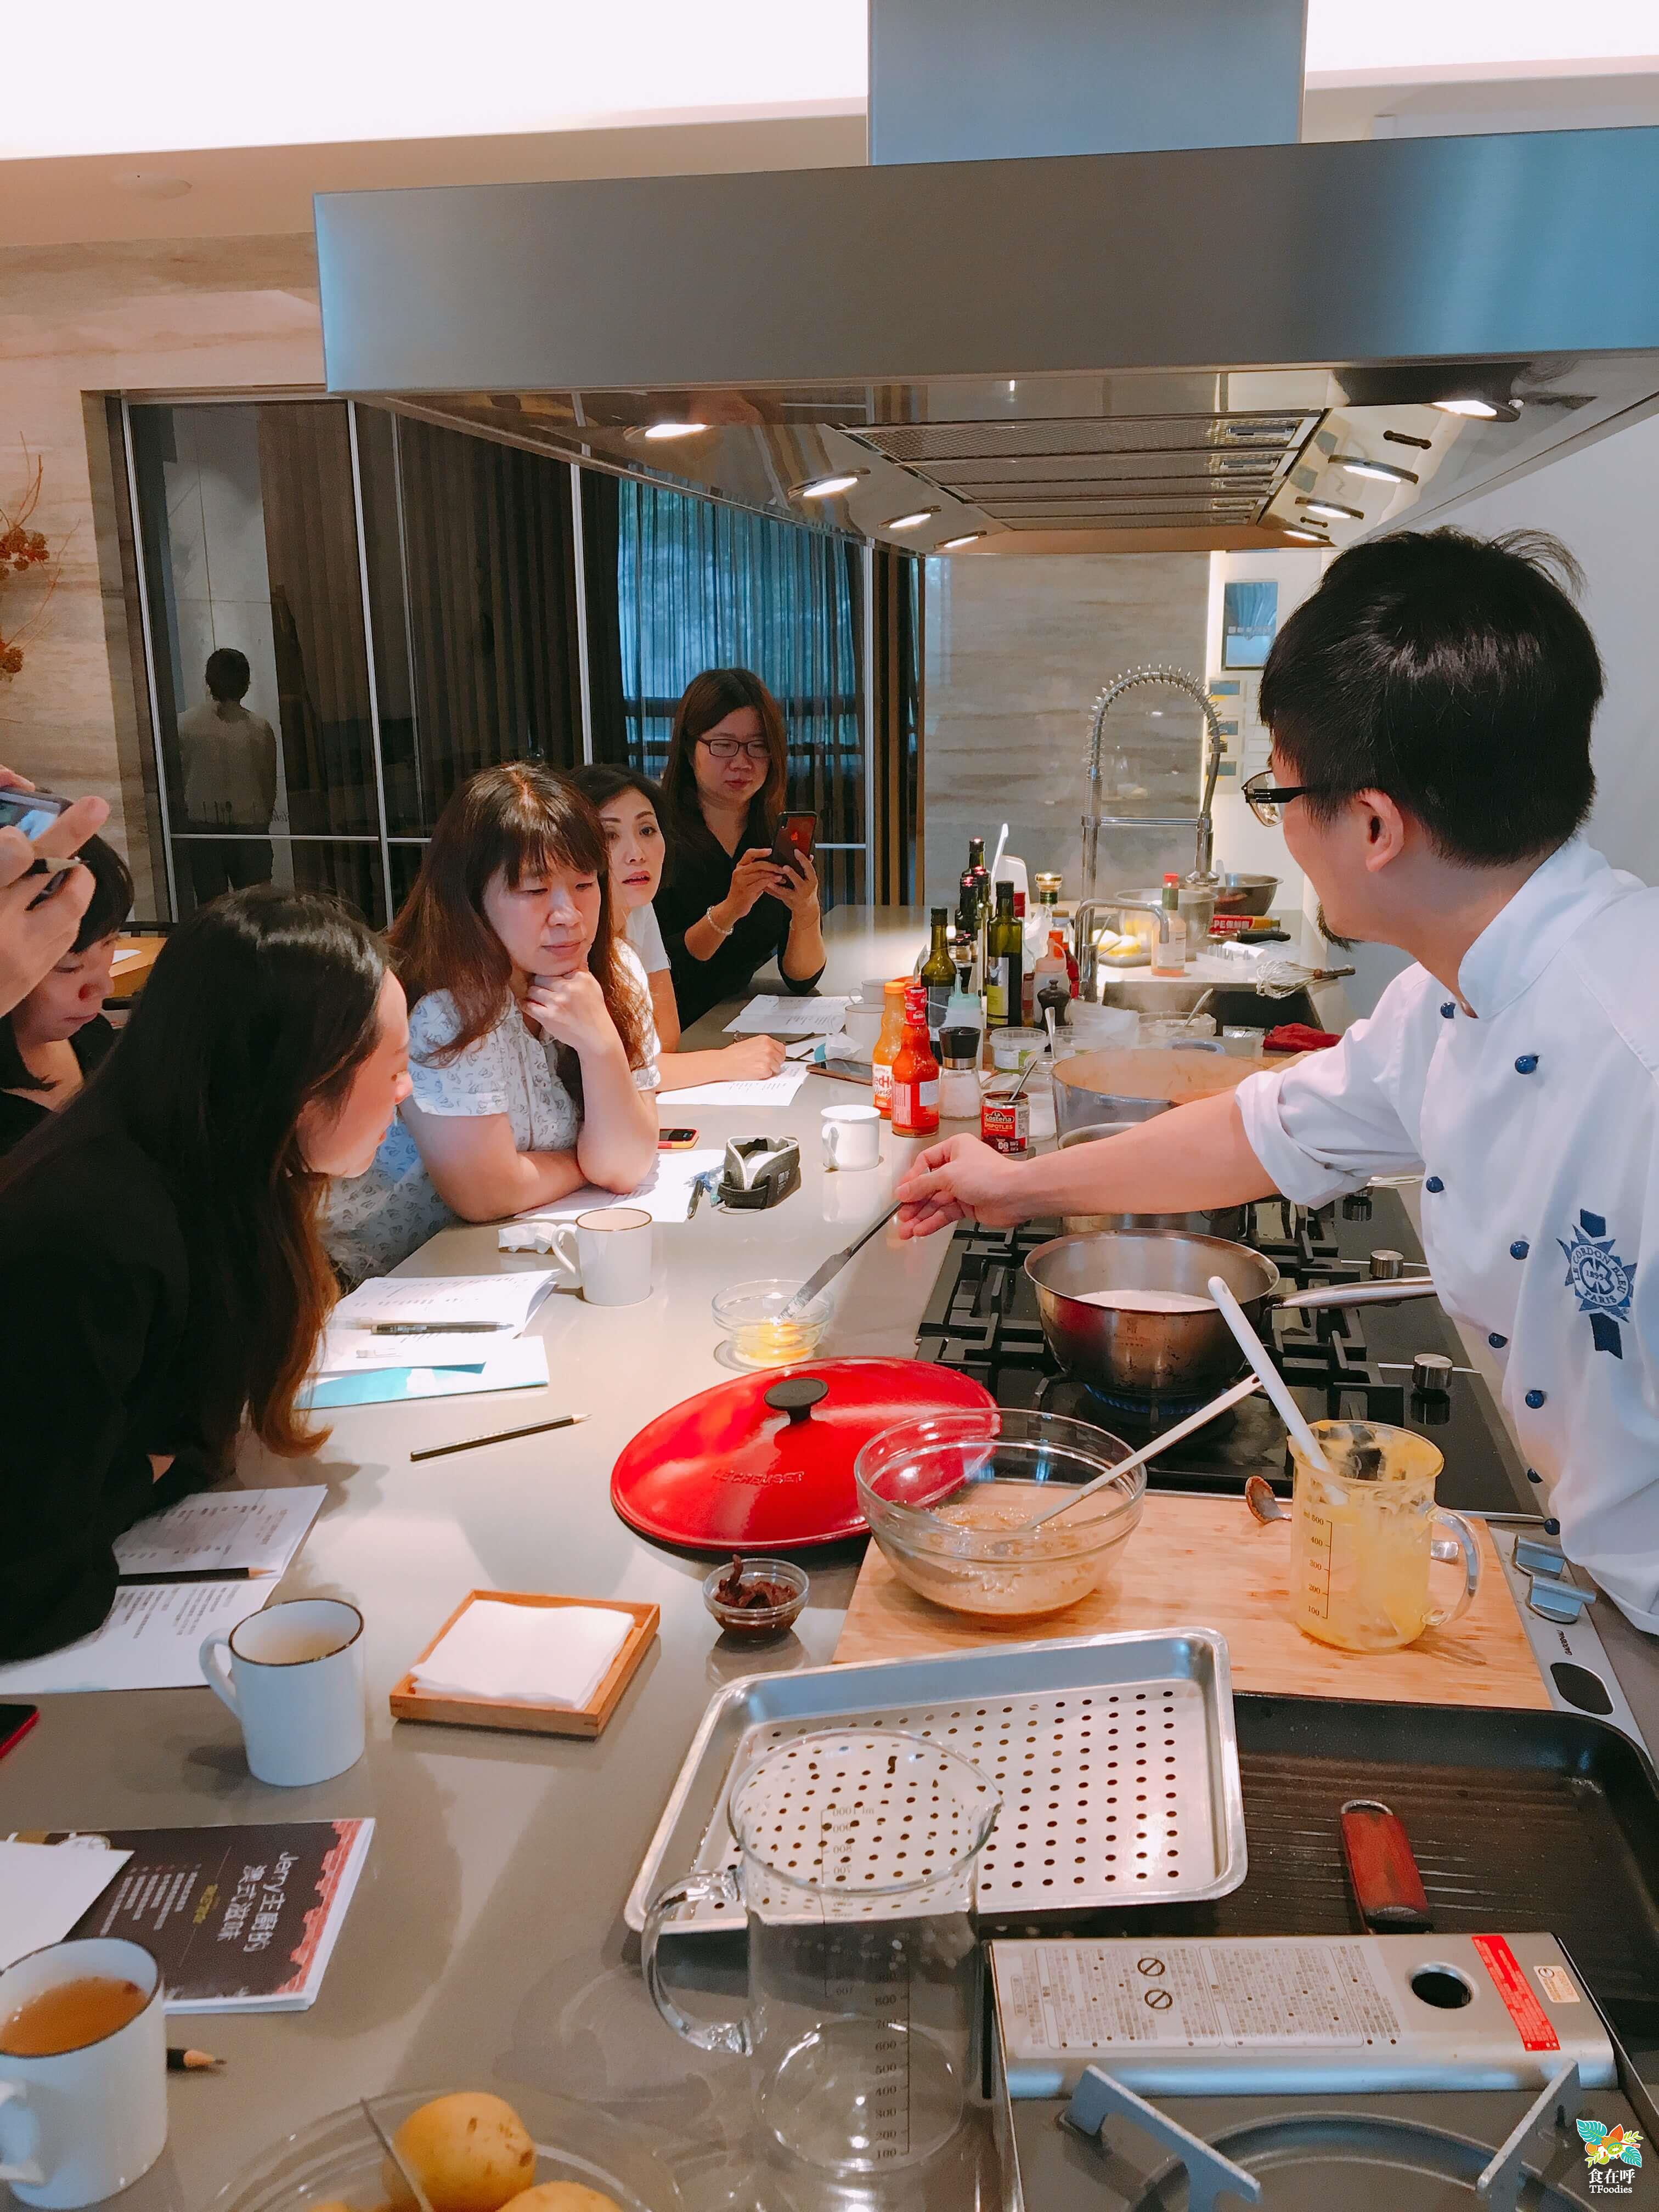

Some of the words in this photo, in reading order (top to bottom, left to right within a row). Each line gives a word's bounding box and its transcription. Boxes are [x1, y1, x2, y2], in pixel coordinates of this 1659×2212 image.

[1573, 1247, 1611, 1265] CORDON
[1611, 1266, 1627, 1294] BLEU
[1584, 1289, 1617, 1304] PARIS
[1311, 1516, 1324, 1525] 500
[1310, 1536, 1323, 1547] 400
[1309, 1559, 1322, 1571] 300
[1308, 1583, 1321, 1594] 200
[1308, 1605, 1320, 1616] 100
